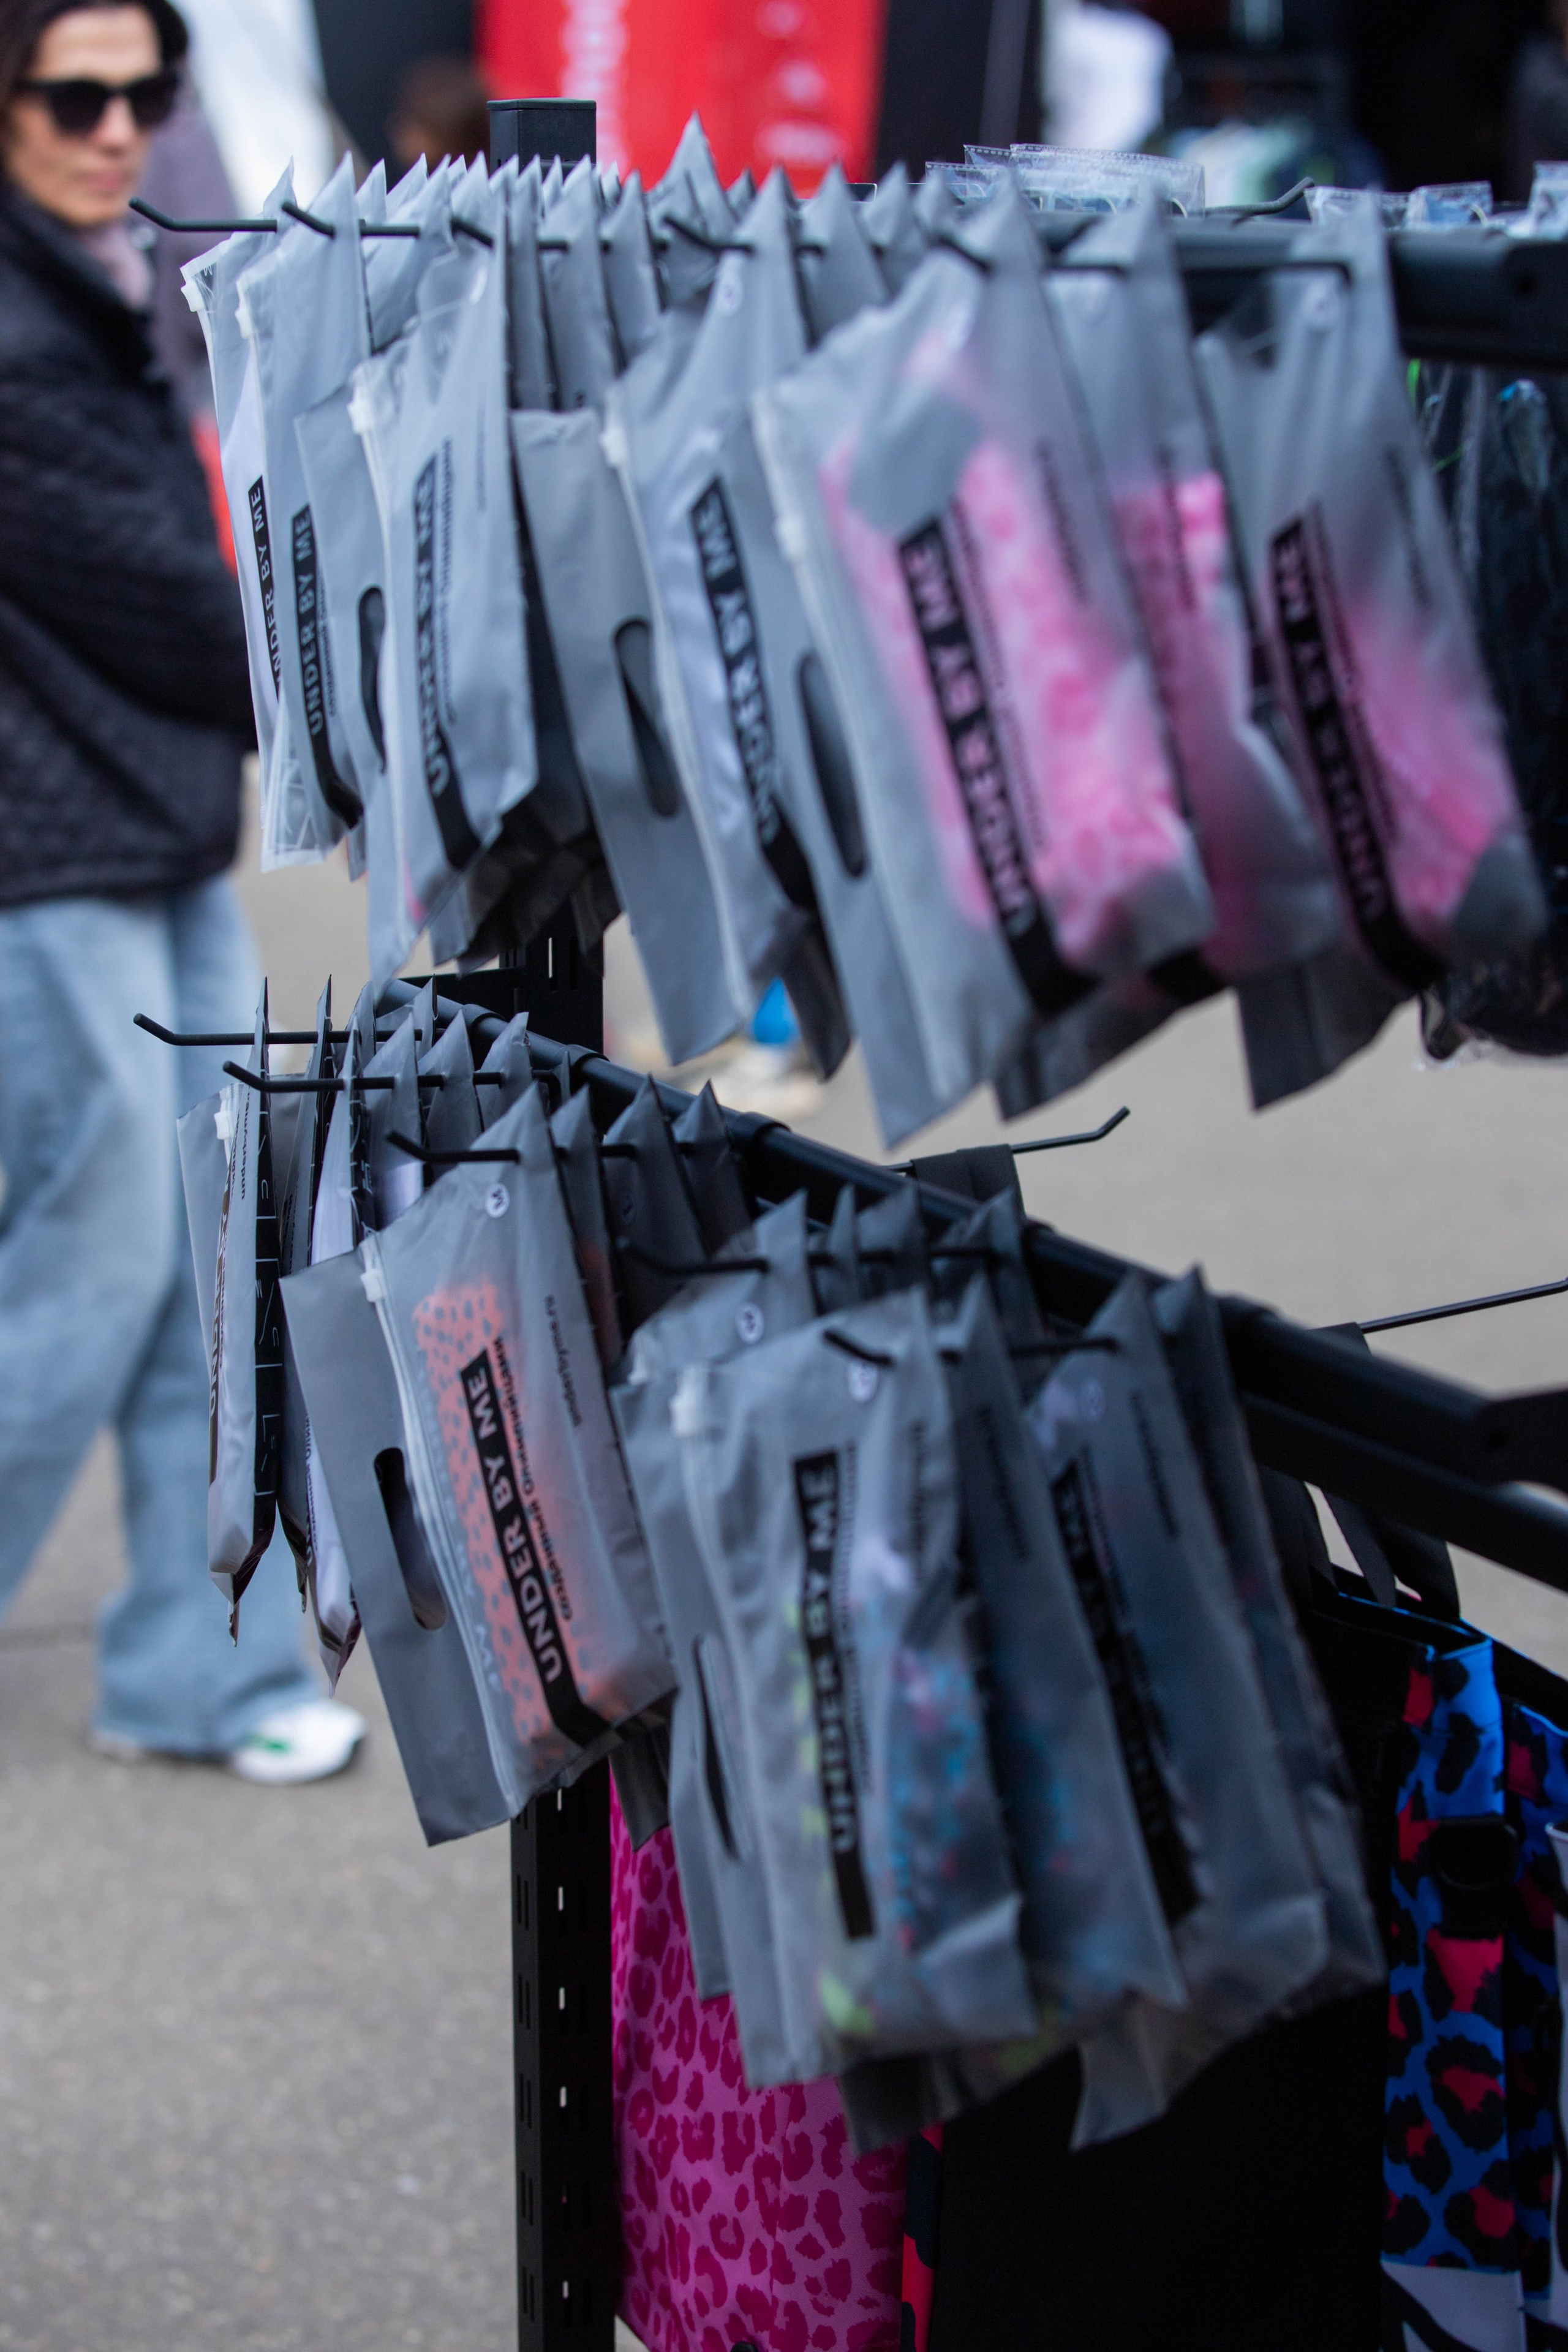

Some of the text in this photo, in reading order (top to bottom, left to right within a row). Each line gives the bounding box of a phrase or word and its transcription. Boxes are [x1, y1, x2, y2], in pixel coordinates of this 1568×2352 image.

[252, 486, 281, 685] NDER BY ME
[295, 516, 313, 563] ME
[298, 572, 315, 614] BY
[301, 623, 323, 736] UNDER
[467, 1366, 563, 1683] UNDER BY ME
